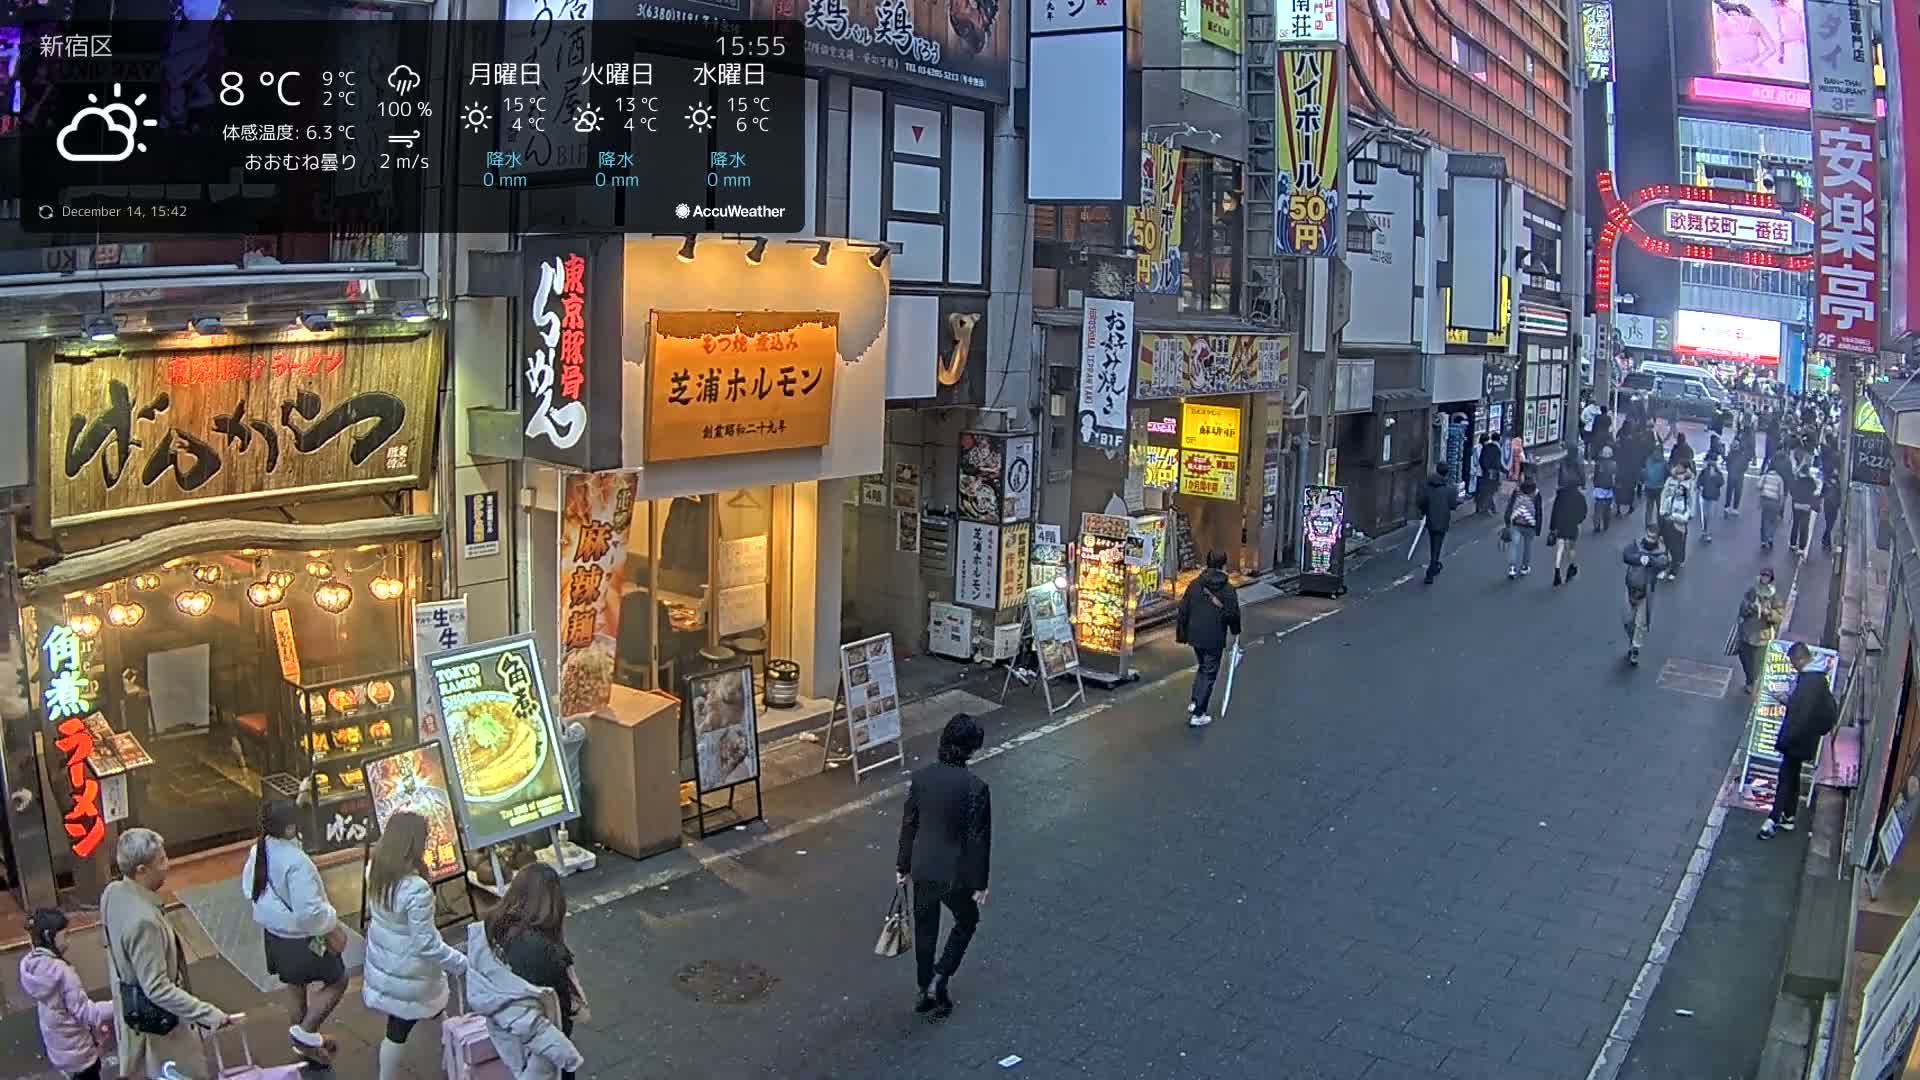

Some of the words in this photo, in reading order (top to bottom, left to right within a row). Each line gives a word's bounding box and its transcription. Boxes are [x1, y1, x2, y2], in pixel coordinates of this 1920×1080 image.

[1587, 63, 1609, 80] 7F
[1295, 54, 1321, 190] ハイボール
[1160, 150, 1175, 289] ハイボール
[1670, 211, 1789, 242] 歌舞伎町一番街
[1819, 127, 1877, 330] 安楽亭
[561, 253, 585, 400] 東京豚骨
[1817, 332, 1837, 348] 2F
[1098, 309, 1128, 416] お好み焼き
[668, 365, 823, 406] 芝浦ホルモン
[702, 419, 787, 440] 創業昭和二十九年
[435, 662, 481, 683] TOKYO
[438, 677, 482, 697] RAMEN
[43, 624, 105, 858] 角煮ラーメン
